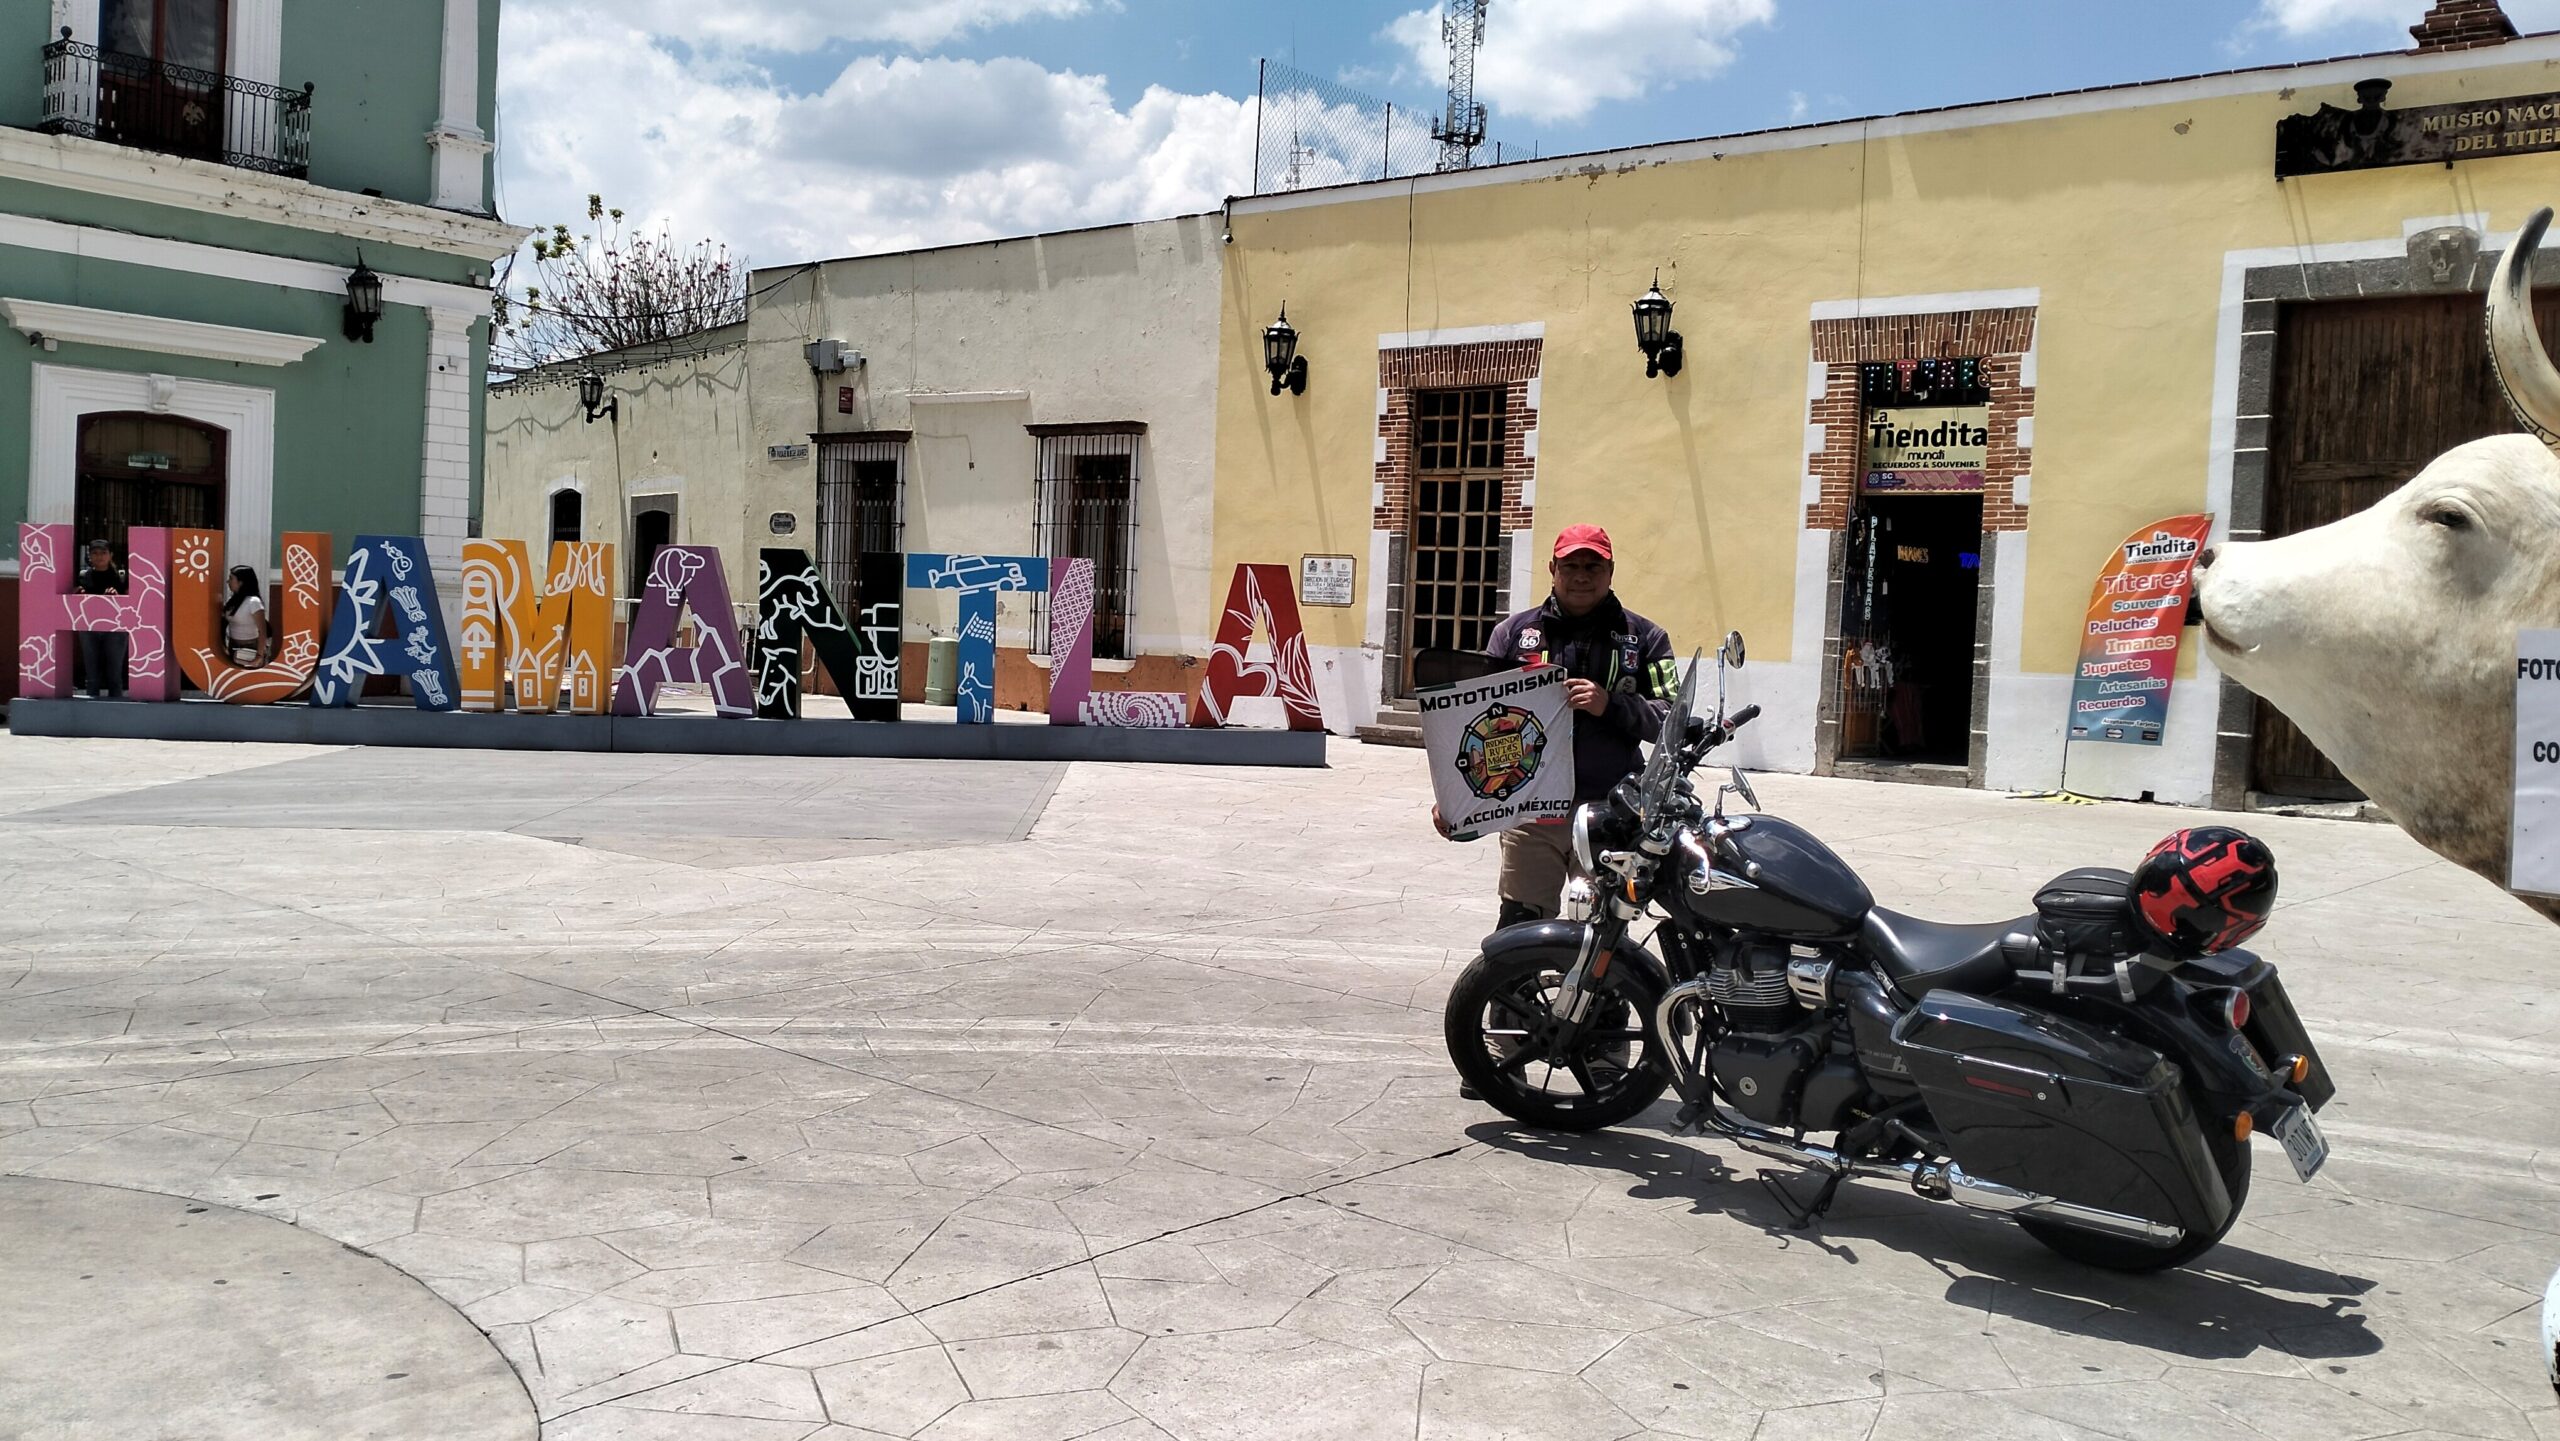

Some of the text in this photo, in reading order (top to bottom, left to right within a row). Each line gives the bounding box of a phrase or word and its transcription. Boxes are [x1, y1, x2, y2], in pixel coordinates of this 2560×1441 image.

[2422, 110, 2501, 132] MUSEO
[2456, 134, 2497, 151] DEL
[1870, 409, 1888, 422] La
[1870, 421, 1988, 448] Tiendita
[1872, 461, 1920, 469] RECUERDOS
[1931, 460, 1980, 469] SOUVENIRS
[2156, 532, 2168, 541] La
[2125, 539, 2196, 558] Tiendita
[2113, 595, 2181, 612] Souvenirs
[19, 522, 1324, 731] HUAMANTLA
[2089, 617, 2157, 635] Peluches
[1522, 636, 1537, 647] 66
[2106, 636, 2176, 654] Imanes
[2082, 659, 2150, 677] Juguetes
[1420, 668, 1565, 712] MOTOTURISMO
[2100, 679, 2167, 693] Artesanías
[1493, 706, 1503, 714] N
[2078, 697, 2145, 711] Recuerdos
[1498, 788, 1507, 796] S
[1463, 804, 1514, 827] ACCIÓN
[1518, 797, 1570, 813] MÉXICO
